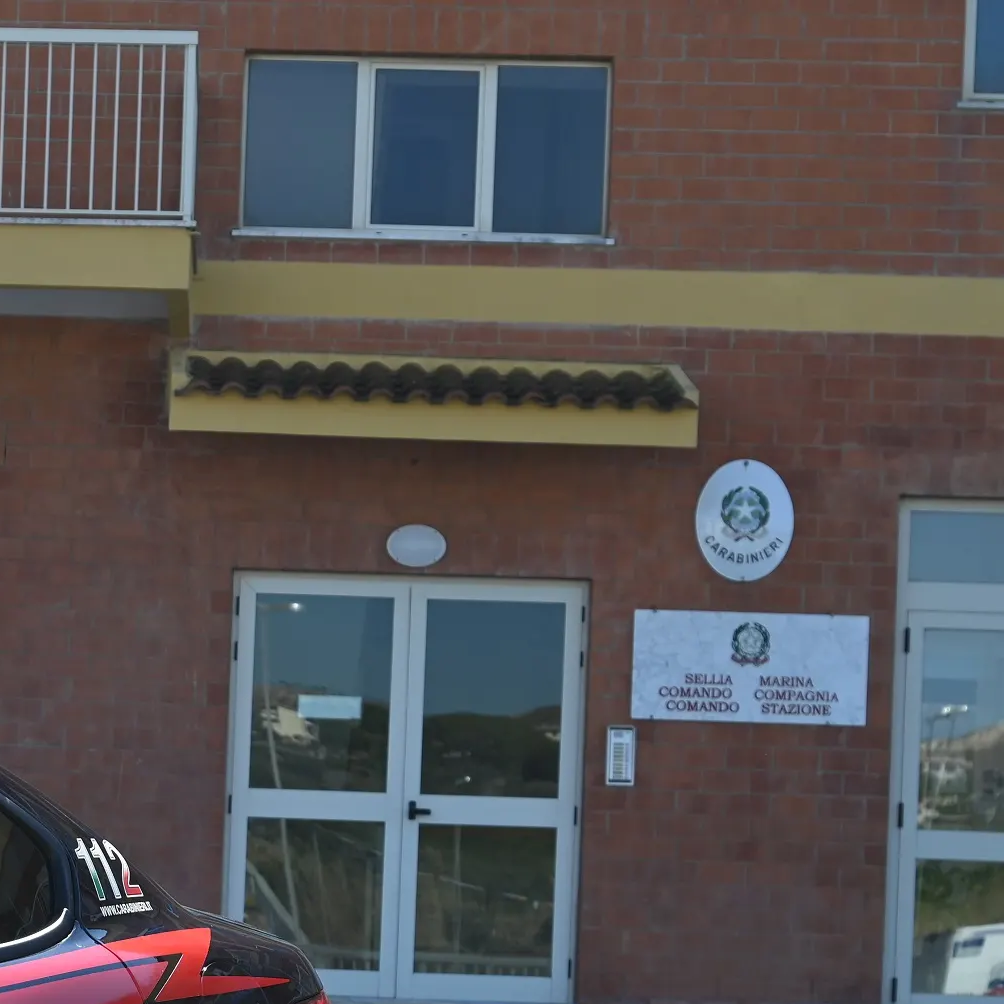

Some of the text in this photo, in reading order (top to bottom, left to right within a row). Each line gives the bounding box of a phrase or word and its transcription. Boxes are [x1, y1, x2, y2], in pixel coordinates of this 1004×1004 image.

[704, 535, 784, 564] CARABINIERI
[684, 673, 814, 688] SELLIA MARINA
[658, 685, 839, 702] COMANDO COMPAGNIA
[666, 699, 832, 716] COMANDO STAZIONE
[74, 838, 144, 901] 112
